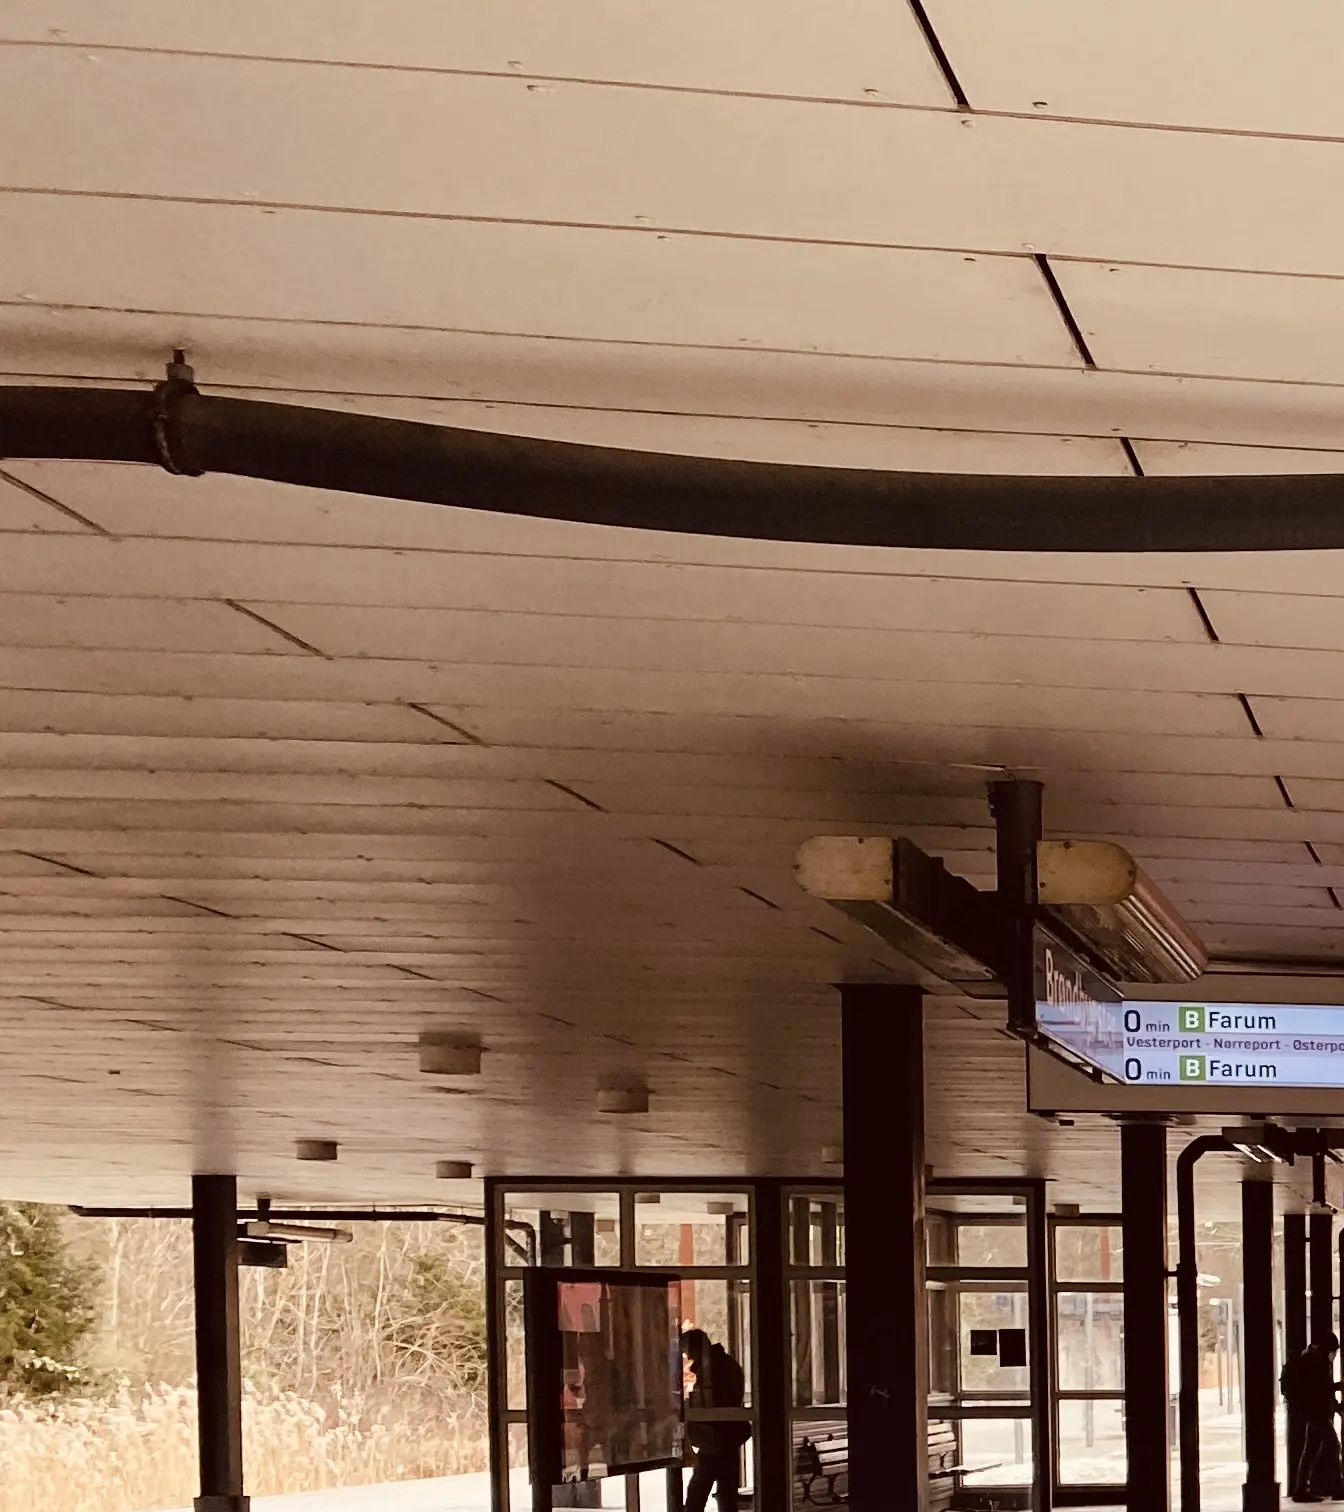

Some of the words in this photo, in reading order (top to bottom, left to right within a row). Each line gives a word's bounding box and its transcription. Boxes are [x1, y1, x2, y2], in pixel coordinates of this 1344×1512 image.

[1124, 1009, 1141, 1033] 0
[1145, 1021, 1170, 1033] min
[1185, 1010, 1200, 1029] B
[1209, 1011, 1277, 1030] Farum
[1126, 1036, 1201, 1050] Vesterport
[1213, 1038, 1281, 1051] Nørreport
[1125, 1057, 1142, 1081] 0
[1146, 1068, 1171, 1080] min
[1185, 1058, 1200, 1077] B
[1209, 1059, 1277, 1078] Farum
